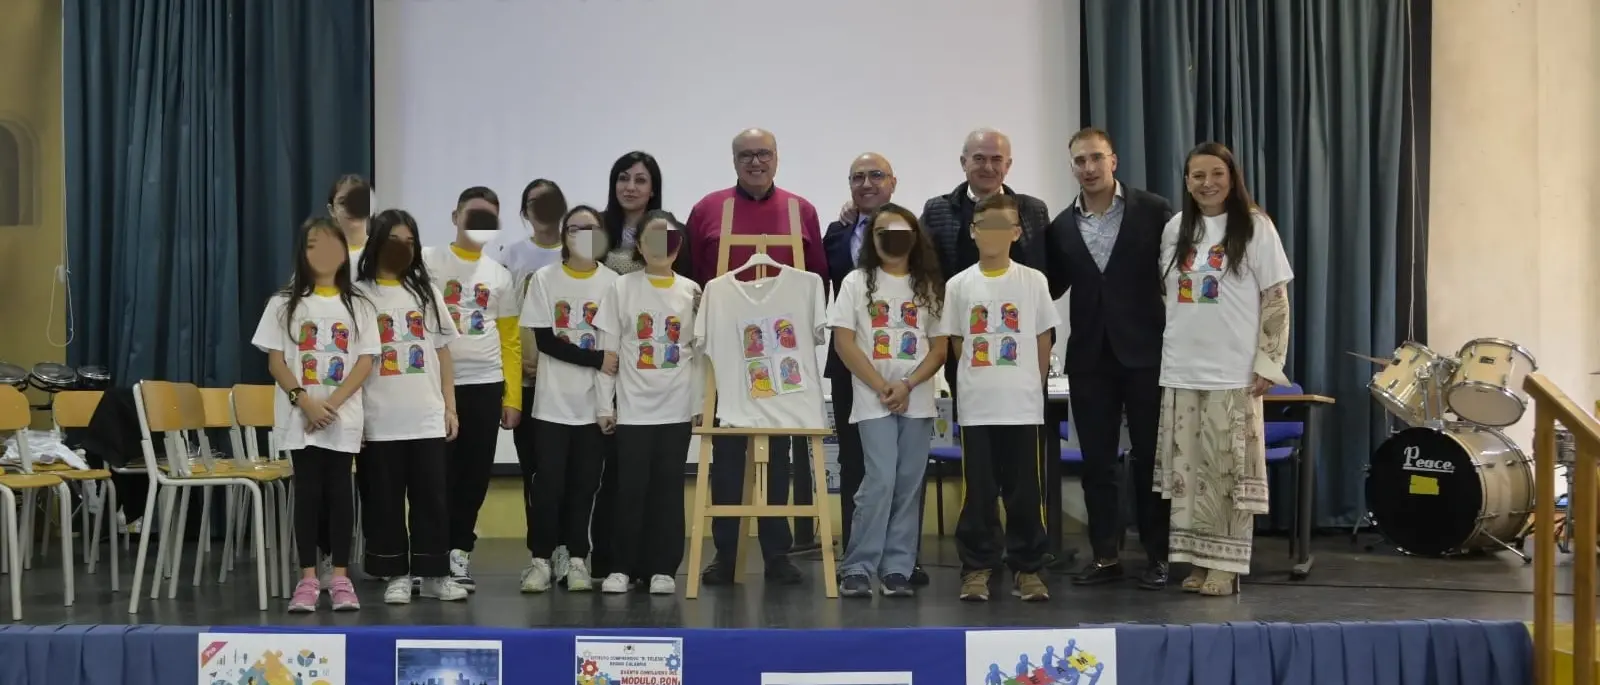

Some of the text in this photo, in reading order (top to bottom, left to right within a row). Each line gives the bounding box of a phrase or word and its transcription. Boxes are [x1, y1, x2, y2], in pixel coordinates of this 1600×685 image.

[1403, 446, 1453, 470] Peace
[622, 677, 678, 685] MODULO PON
